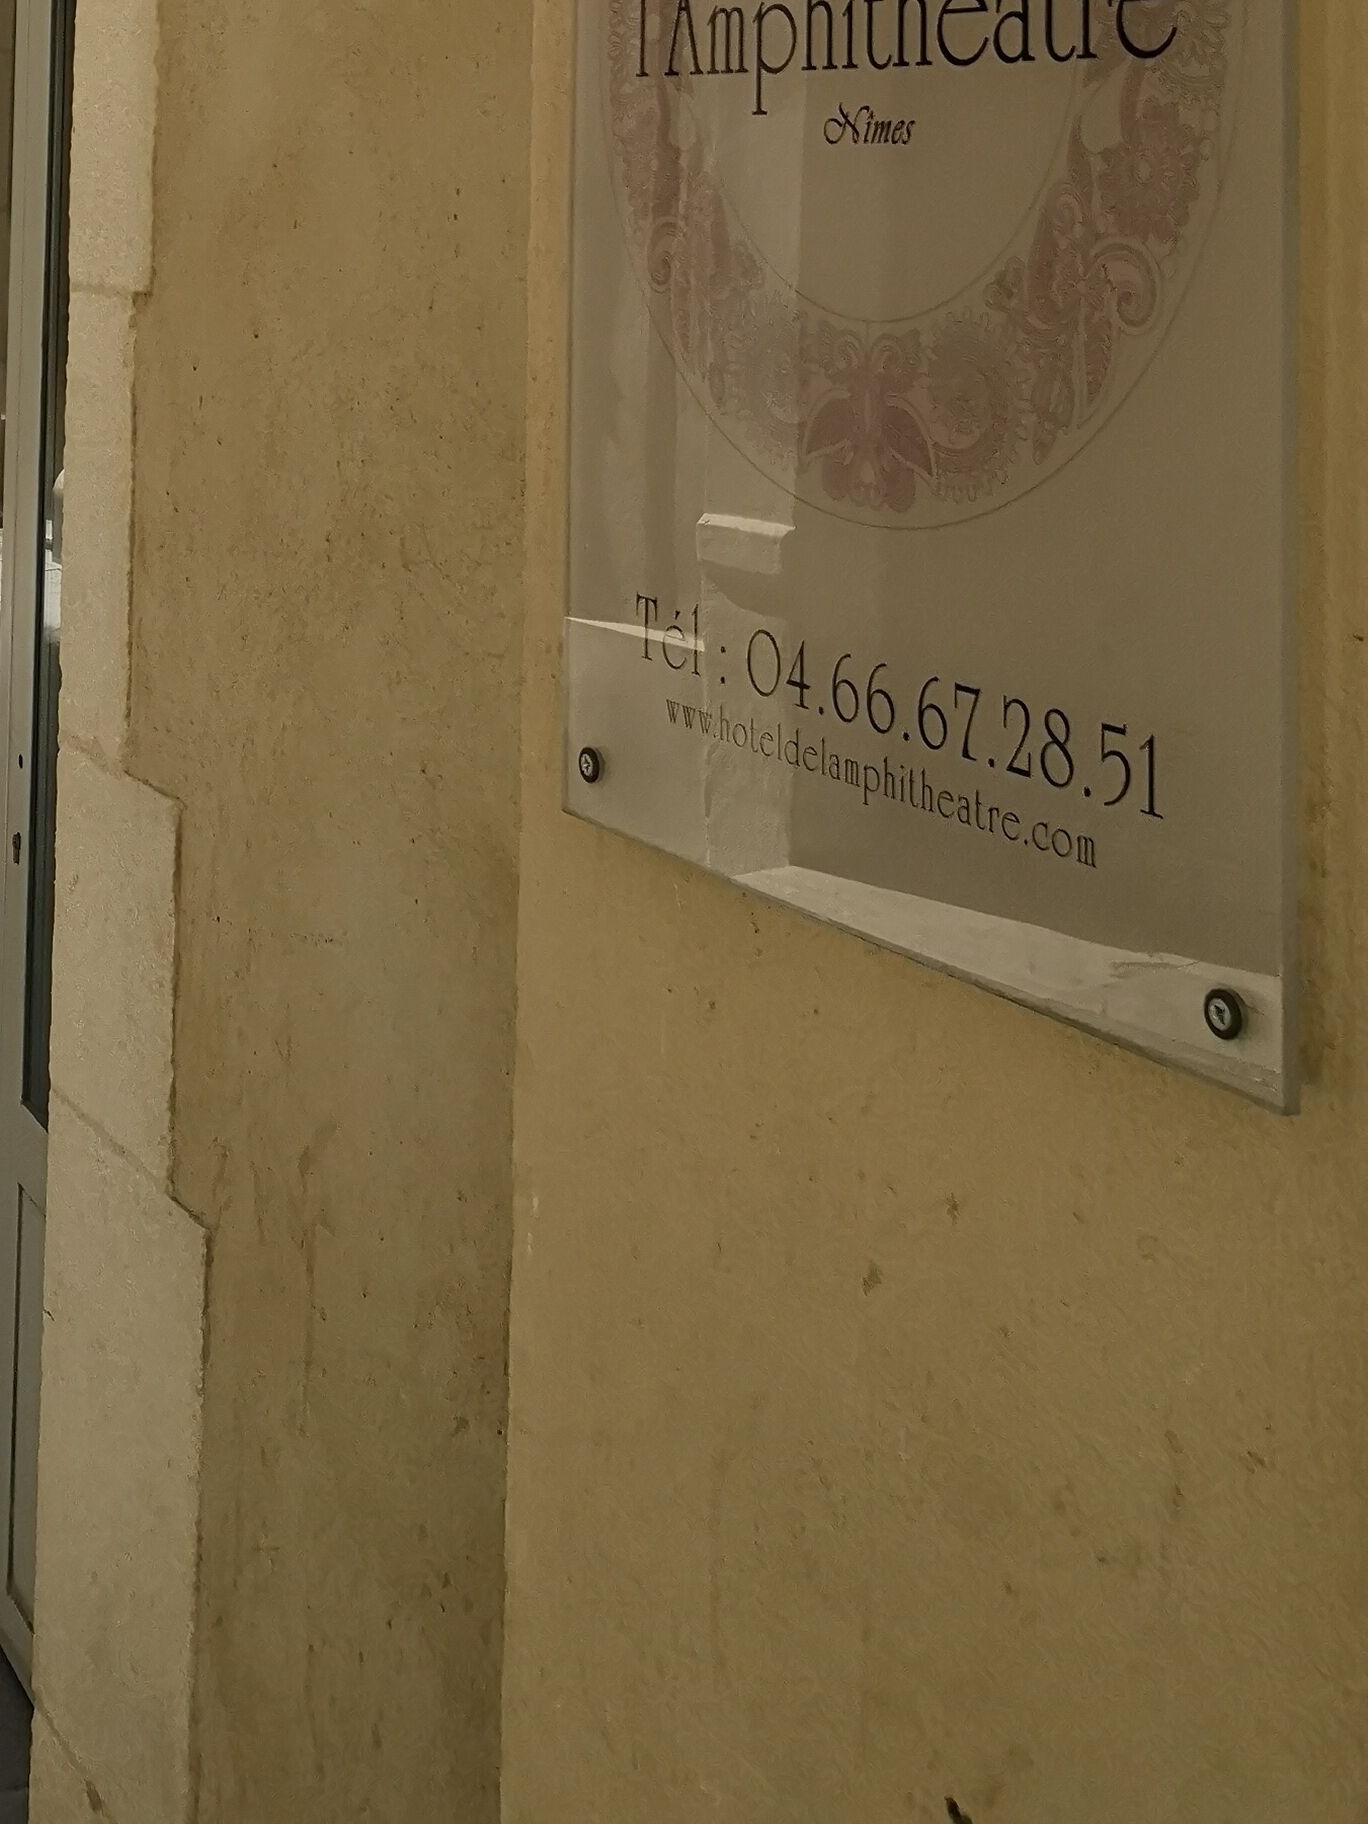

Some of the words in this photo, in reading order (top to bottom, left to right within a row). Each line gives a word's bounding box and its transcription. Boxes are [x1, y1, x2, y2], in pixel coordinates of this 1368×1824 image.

[823, 102, 916, 146] Nîmes
[635, 592, 702, 677] Tél
[746, 629, 1165, 819] 04.66.67.28.51
[665, 695, 1098, 869] www.hoteldelamphitheatre.com
